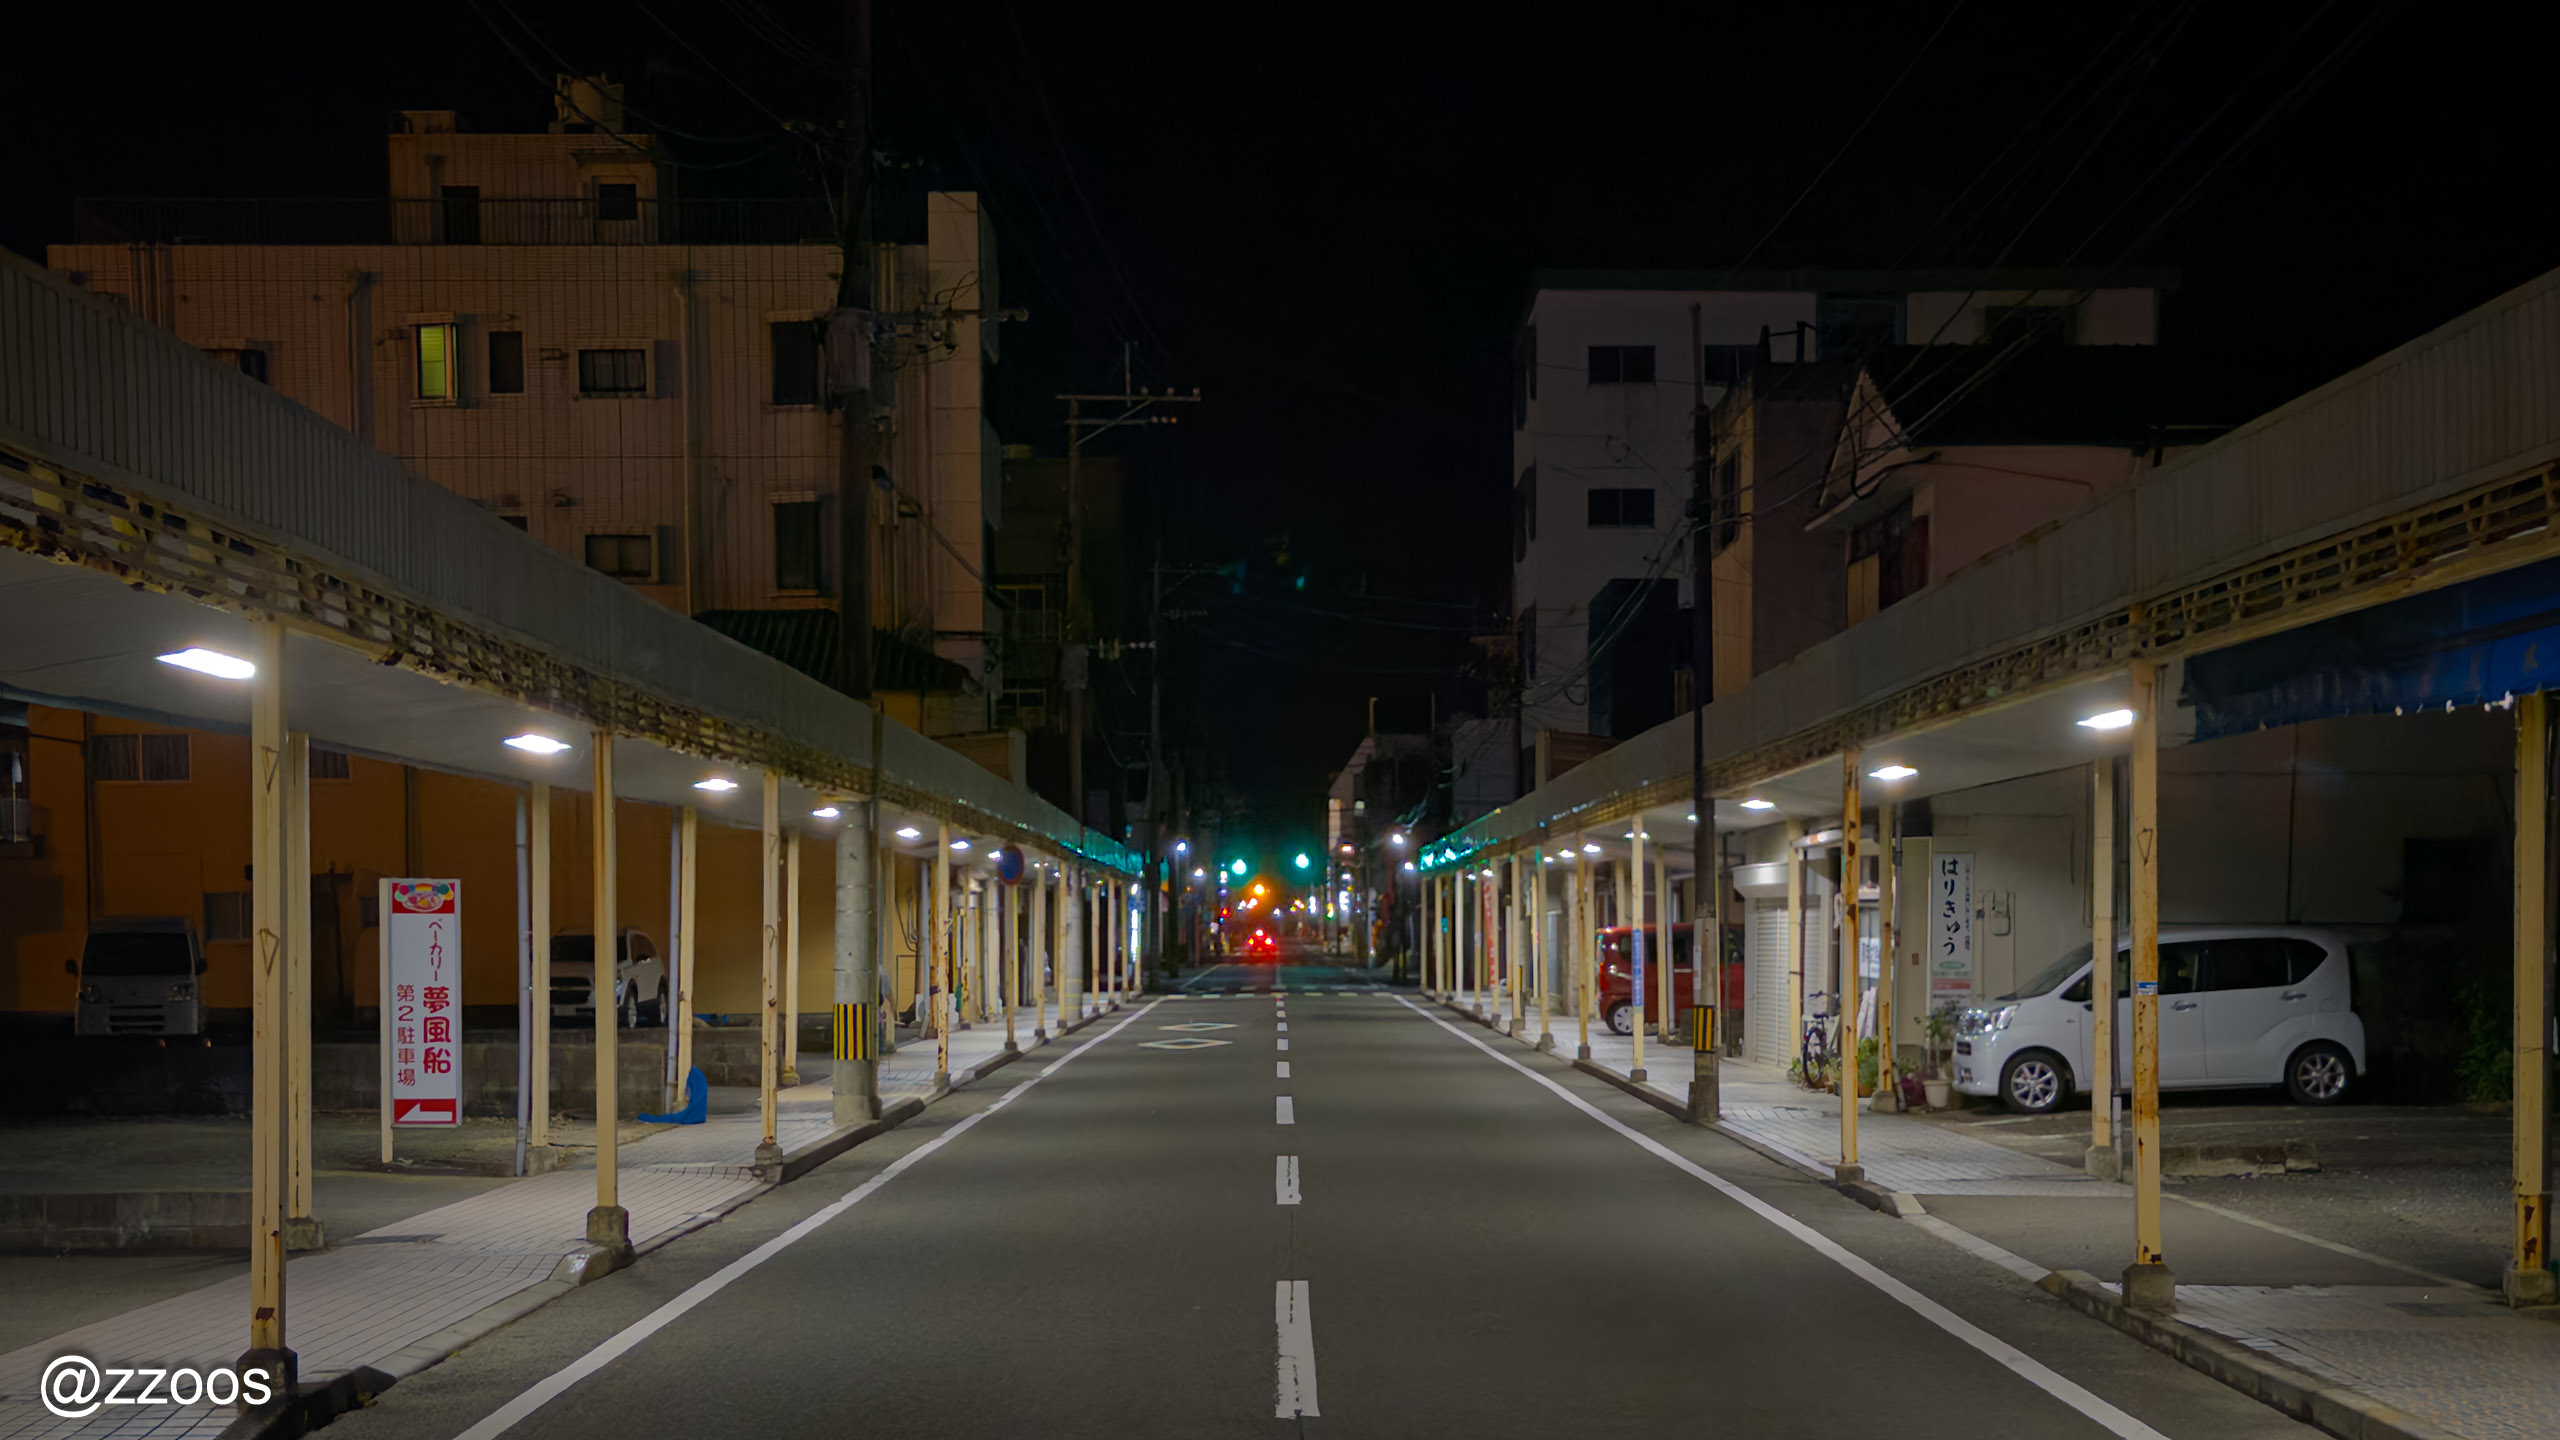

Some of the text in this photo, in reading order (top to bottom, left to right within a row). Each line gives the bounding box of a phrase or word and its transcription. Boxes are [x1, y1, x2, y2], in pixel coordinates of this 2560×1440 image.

[1941, 857, 1961, 956] はりきゅう
[397, 984, 415, 1087] 第2駐車場
[423, 918, 452, 1074] ベーカリー 夢風船
